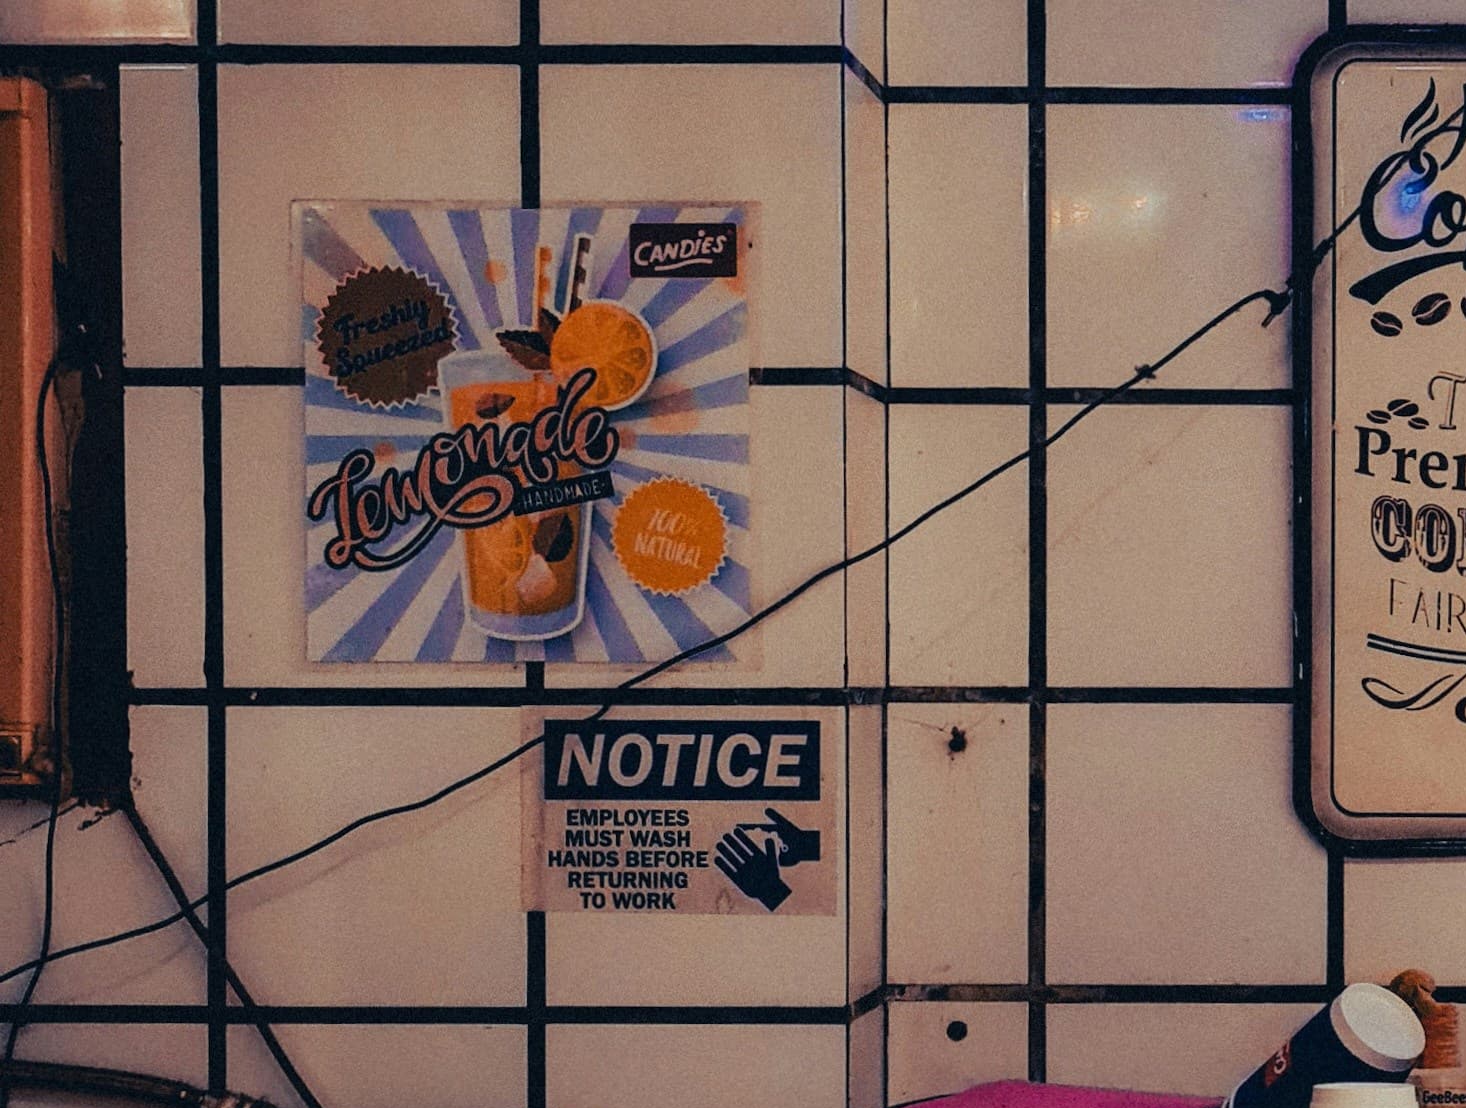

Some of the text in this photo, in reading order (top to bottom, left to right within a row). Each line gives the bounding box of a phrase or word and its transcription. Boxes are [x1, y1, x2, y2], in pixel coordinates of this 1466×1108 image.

[333, 298, 430, 344] Freshly
[336, 317, 452, 377] Squeezed
[308, 367, 620, 571] Lemonade
[634, 532, 703, 568] NATURAL
[557, 733, 808, 788] NOTICE
[566, 809, 689, 826] EMPLOYEES
[565, 830, 690, 847] MUST WASH
[548, 851, 709, 868] HANDS BEFORE
[568, 872, 688, 889] RETURNING
[580, 893, 676, 909] TO WORK
